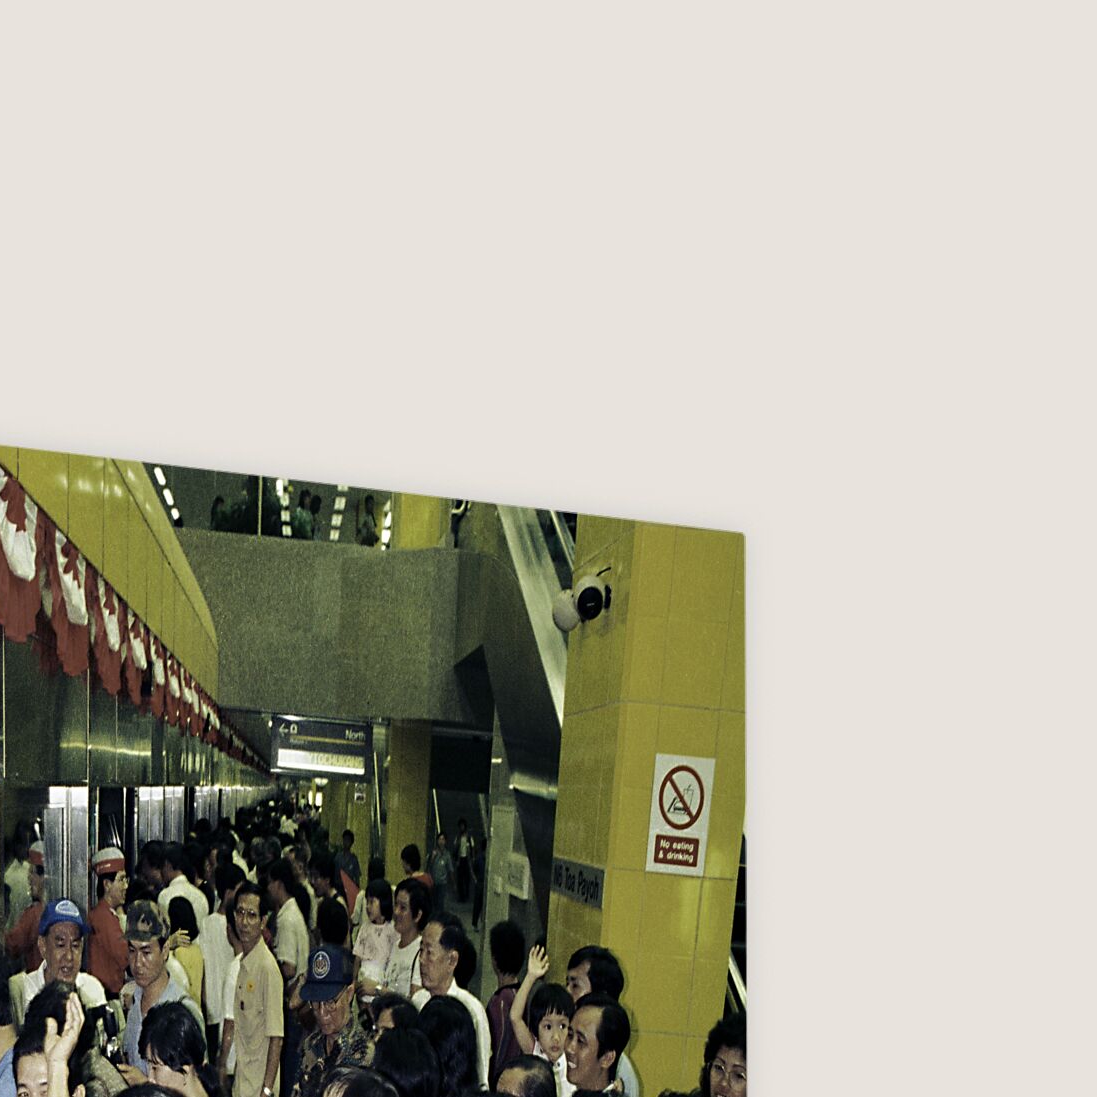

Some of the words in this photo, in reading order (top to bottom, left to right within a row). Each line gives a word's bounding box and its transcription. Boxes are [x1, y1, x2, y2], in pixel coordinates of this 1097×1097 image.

[345, 728, 365, 741] North
[660, 839, 670, 849] No
[673, 841, 694, 853] eating
[658, 850, 663, 859] &
[666, 851, 694, 863] drinking
[565, 867, 575, 892] Toa
[577, 870, 599, 903] Payoh
